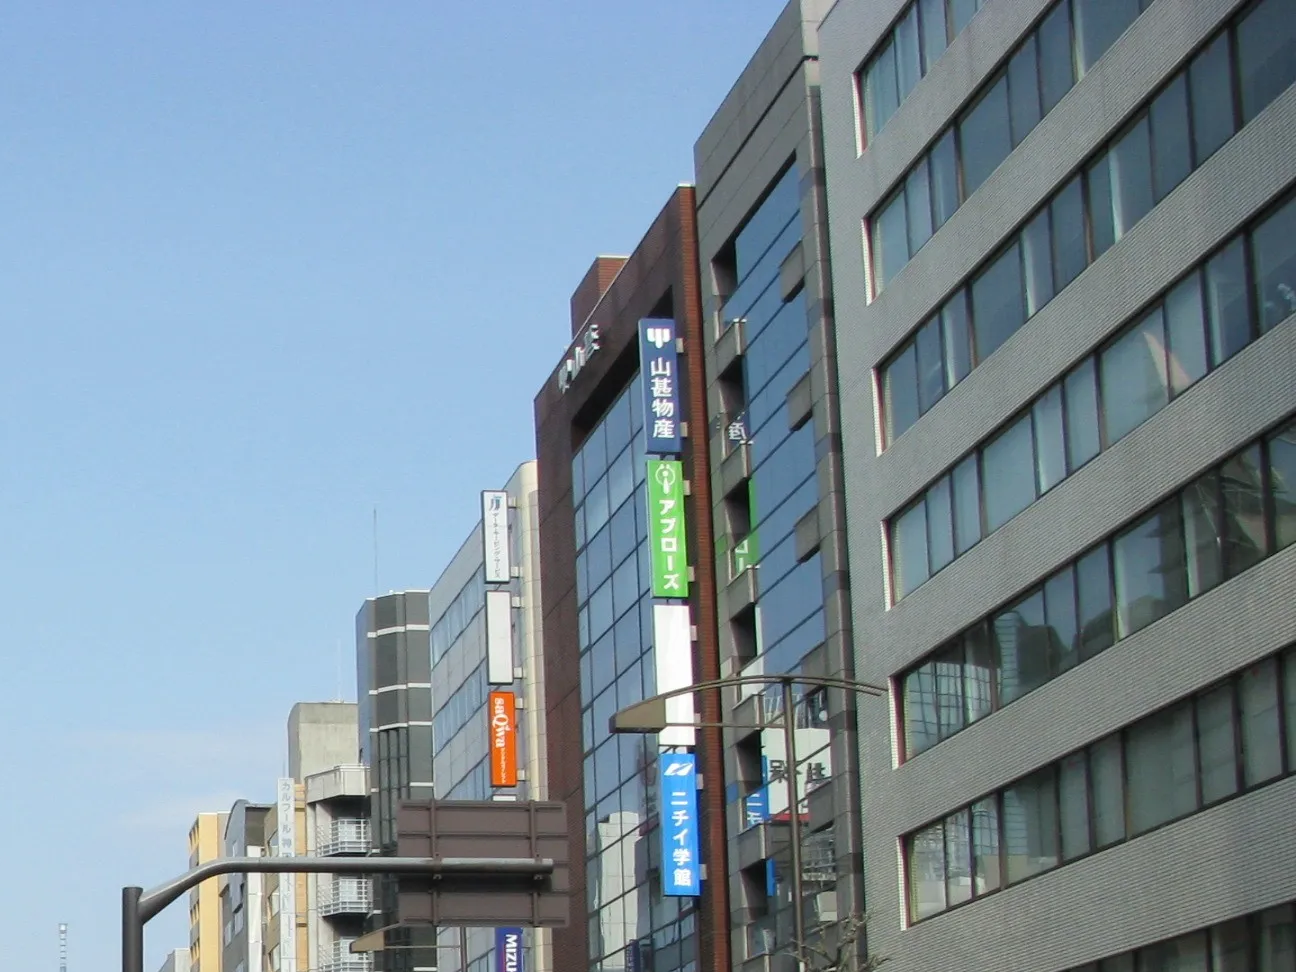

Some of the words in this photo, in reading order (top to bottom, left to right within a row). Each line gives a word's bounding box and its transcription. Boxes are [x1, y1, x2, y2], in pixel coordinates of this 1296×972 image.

[650, 357, 675, 439] 山甚物産
[671, 791, 692, 888] ニチイ学館
